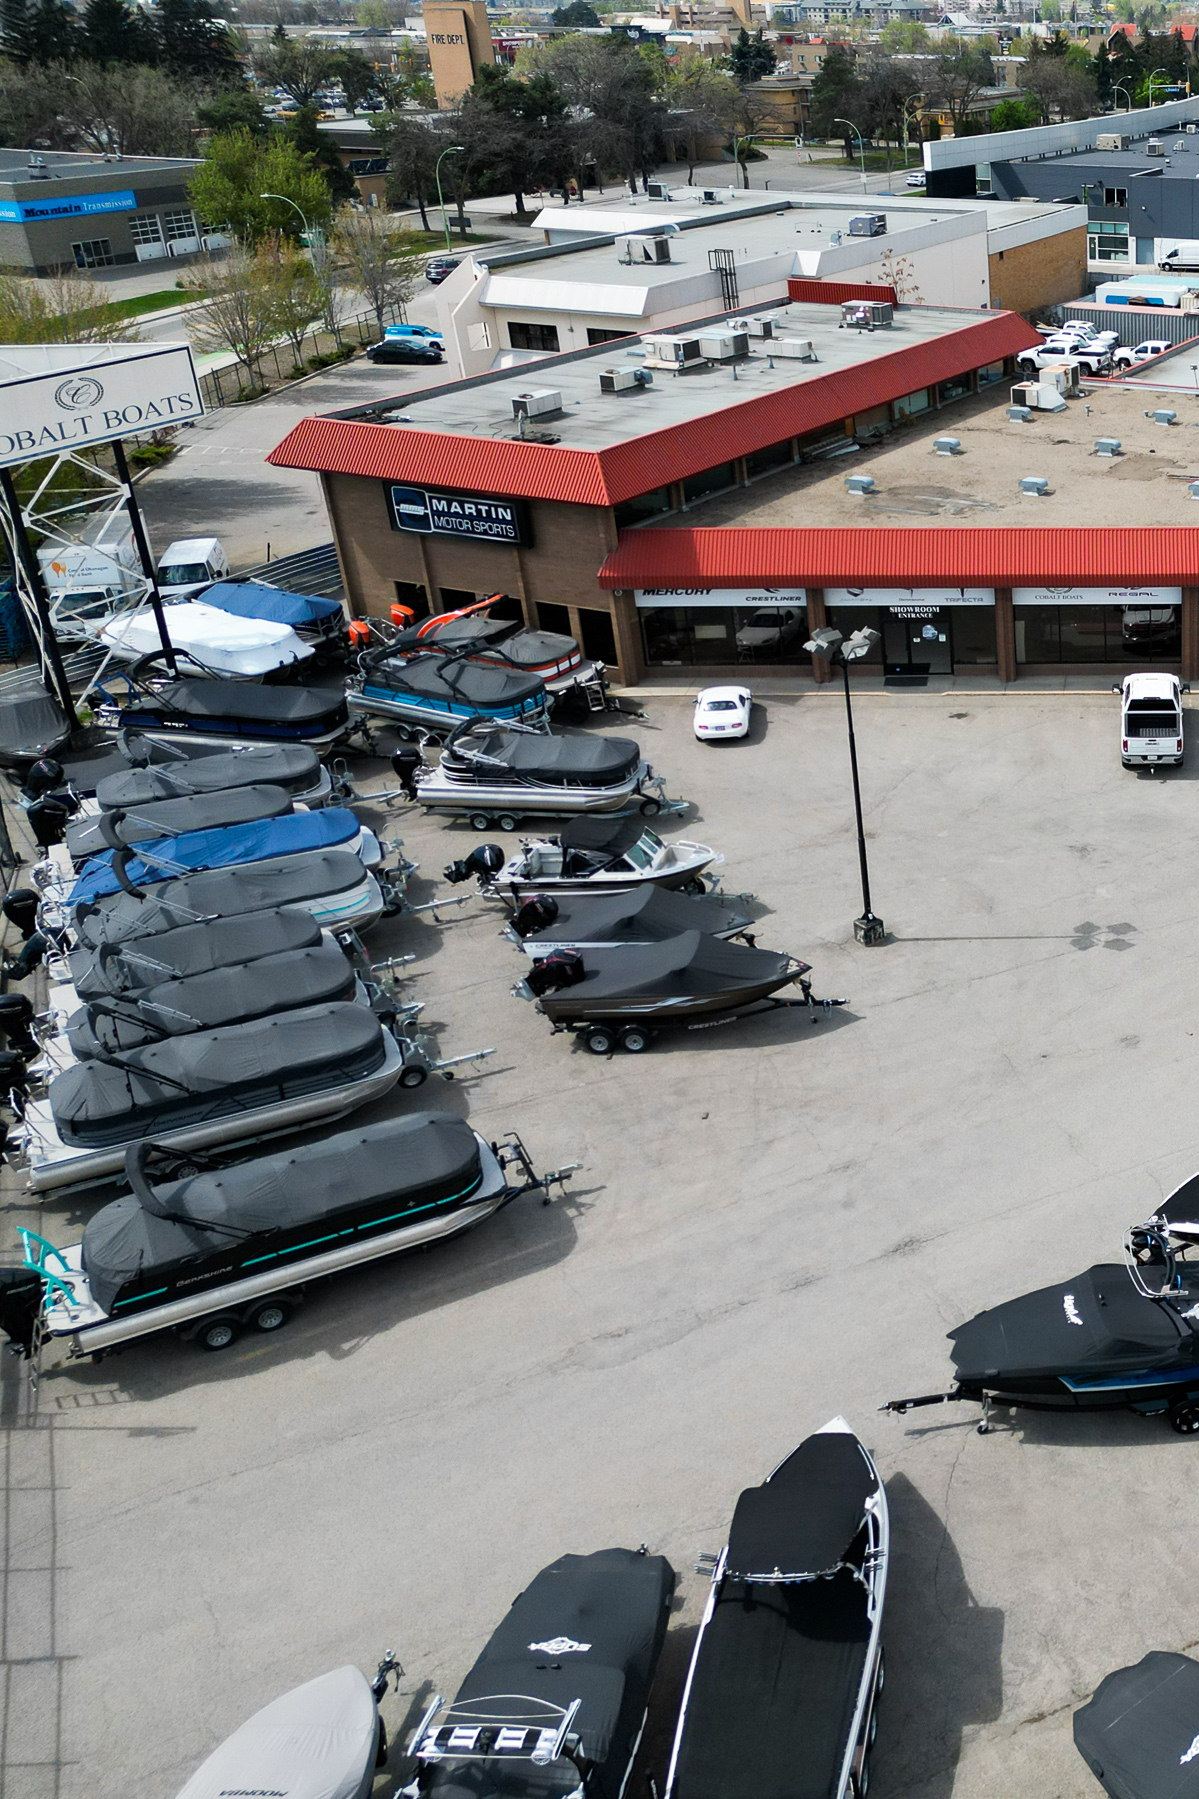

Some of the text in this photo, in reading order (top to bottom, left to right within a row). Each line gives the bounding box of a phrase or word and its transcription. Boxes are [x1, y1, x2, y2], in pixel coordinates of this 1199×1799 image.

[431, 34, 446, 44] FIRE
[24, 204, 82, 218] Mountain
[83, 198, 133, 211] Transmission
[0, 392, 194, 455] OBALT BOATS
[432, 499, 512, 520] MARTIN
[434, 516, 515, 537] MOTOR SPORTS
[688, 1016, 738, 1030] CRESTLINER
[527, 1638, 592, 1654] SUPRA
